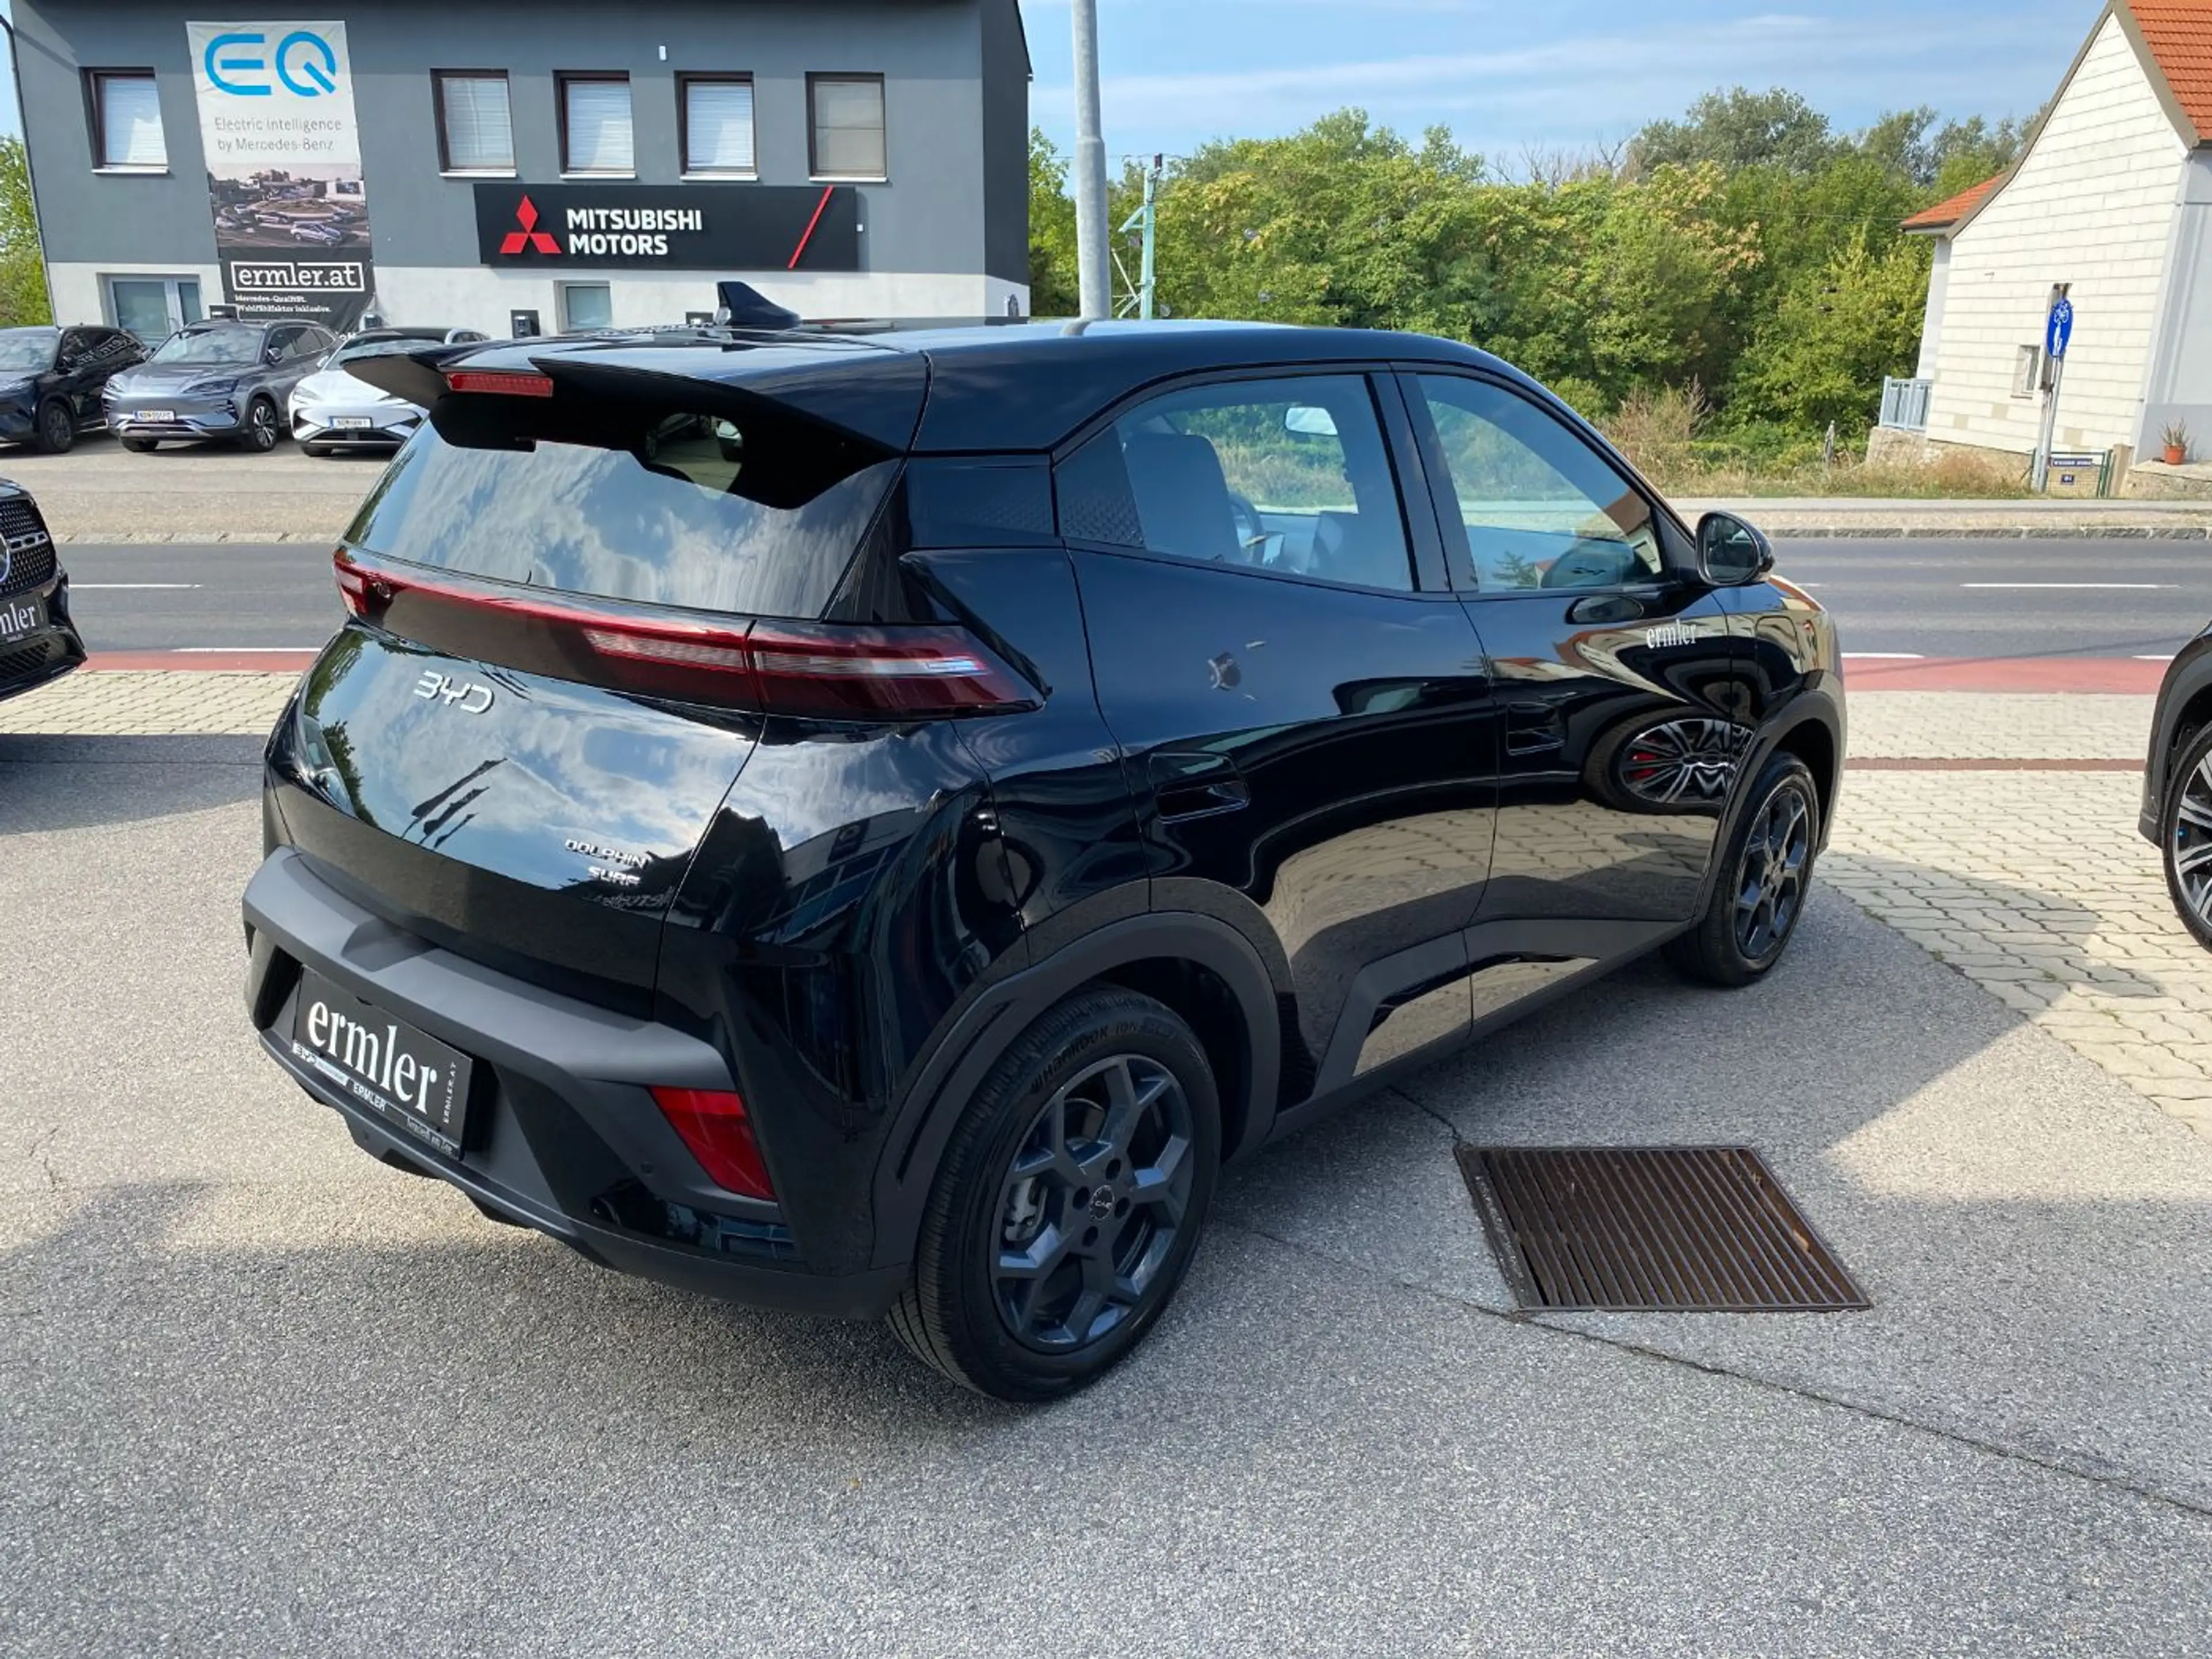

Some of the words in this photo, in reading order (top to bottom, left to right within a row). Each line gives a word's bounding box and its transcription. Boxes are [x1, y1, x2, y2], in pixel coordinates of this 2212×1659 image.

[204, 31, 336, 97] EQ
[214, 117, 263, 131] Electric
[267, 117, 342, 132] Intelligence
[217, 138, 232, 152] by
[236, 138, 334, 151] Mercedes-Benz
[567, 208, 702, 232] MITSUBISHI
[569, 234, 668, 256] MOTORS
[238, 263, 357, 286] ermler.at
[1646, 618, 1697, 649] ermler
[413, 670, 494, 714] BYD
[565, 838, 654, 869] DOLPHIN
[588, 865, 641, 887] SURF
[308, 1001, 438, 1115] ermler
